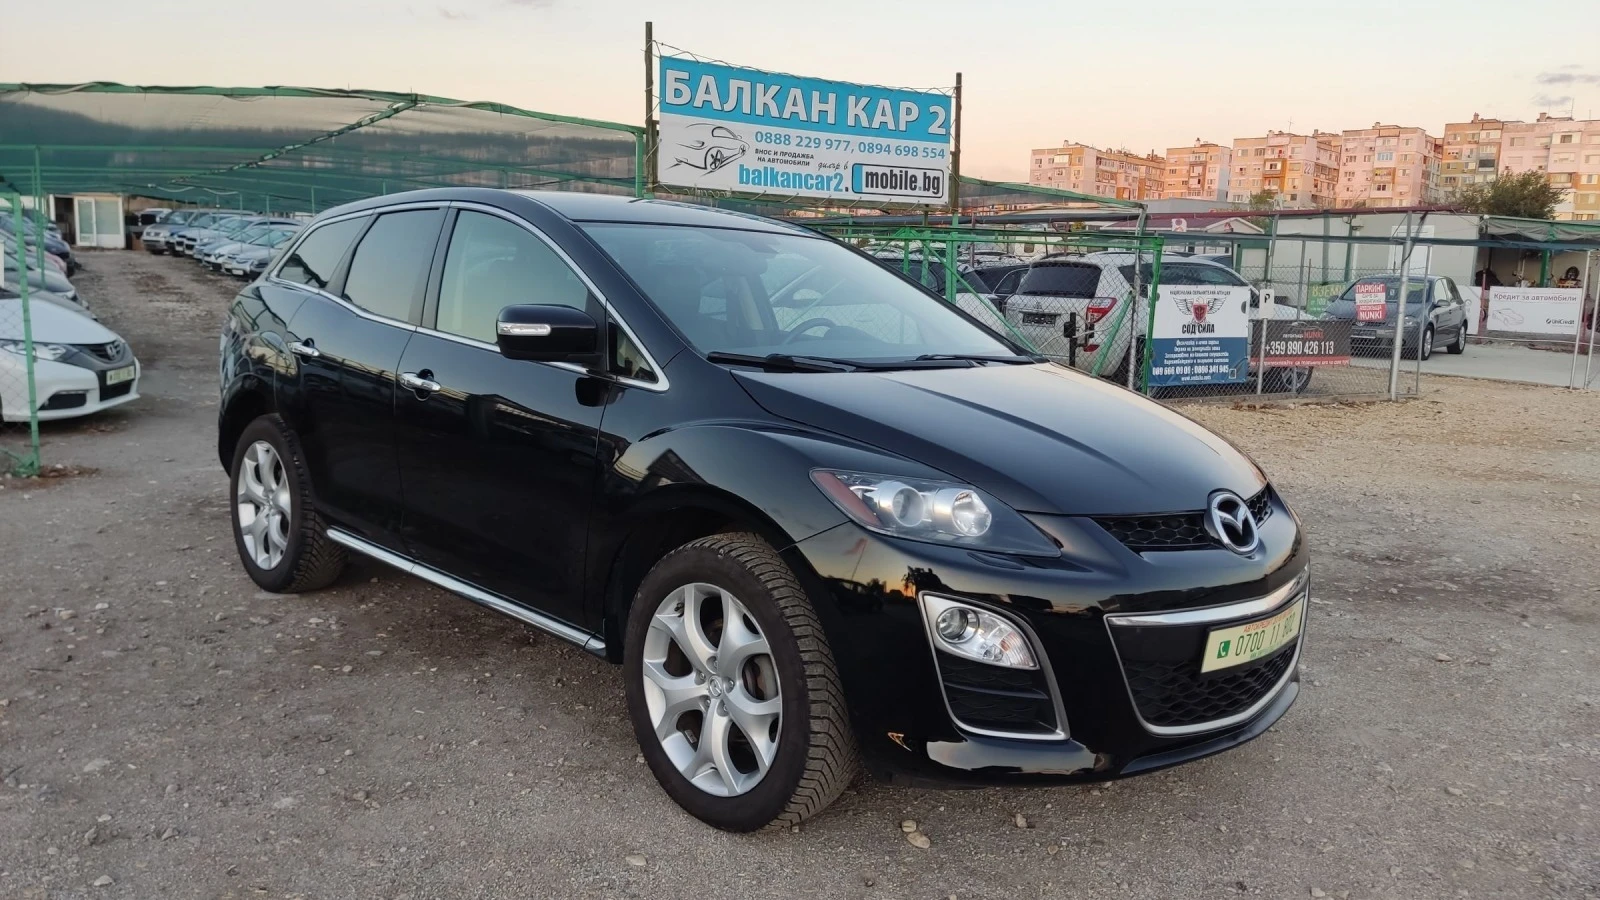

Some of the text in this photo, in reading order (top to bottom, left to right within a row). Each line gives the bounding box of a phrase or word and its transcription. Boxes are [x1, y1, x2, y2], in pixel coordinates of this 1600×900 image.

[666, 69, 946, 135] БАЛКАН КАР 2
[755, 130, 945, 159] 0888 229 977, 0894 698 554
[755, 148, 772, 156] ВНОС
[779, 151, 815, 160] ПРОДАЖБА
[767, 158, 810, 167] АВТОМОБИЛИ
[865, 169, 940, 195] mobile.bg
[1356, 283, 1384, 293] ПАРКИНГ
[1494, 293, 1520, 301] Кредит
[1531, 294, 1577, 302] автомобили
[1359, 311, 1382, 320] NUNKI
[1181, 323, 1215, 335] СОД СИЛА
[1265, 340, 1334, 355] +359 890 426 113
[1235, 630, 1265, 656] 0700
[1269, 623, 1281, 645] 11
